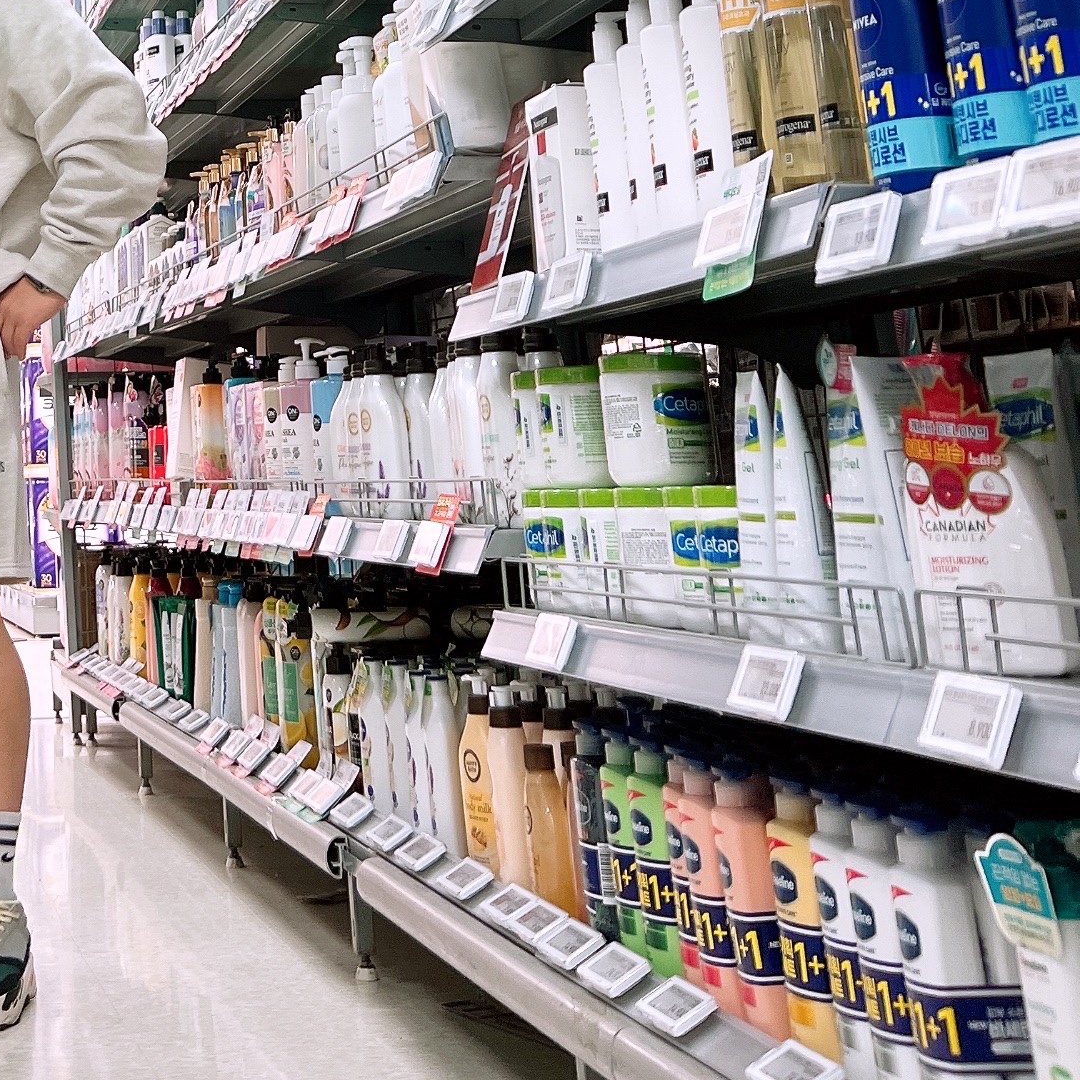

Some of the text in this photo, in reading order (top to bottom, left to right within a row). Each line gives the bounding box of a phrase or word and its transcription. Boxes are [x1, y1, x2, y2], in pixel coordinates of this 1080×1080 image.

[852, 13, 878, 32] NIVEA
[1035, 15, 1058, 28] Care
[960, 40, 980, 52] Care
[875, 66, 894, 78] Care
[35, 449, 47, 459] 30
[925, 519, 987, 533] CANADIAN
[39, 573, 52, 584] 30
